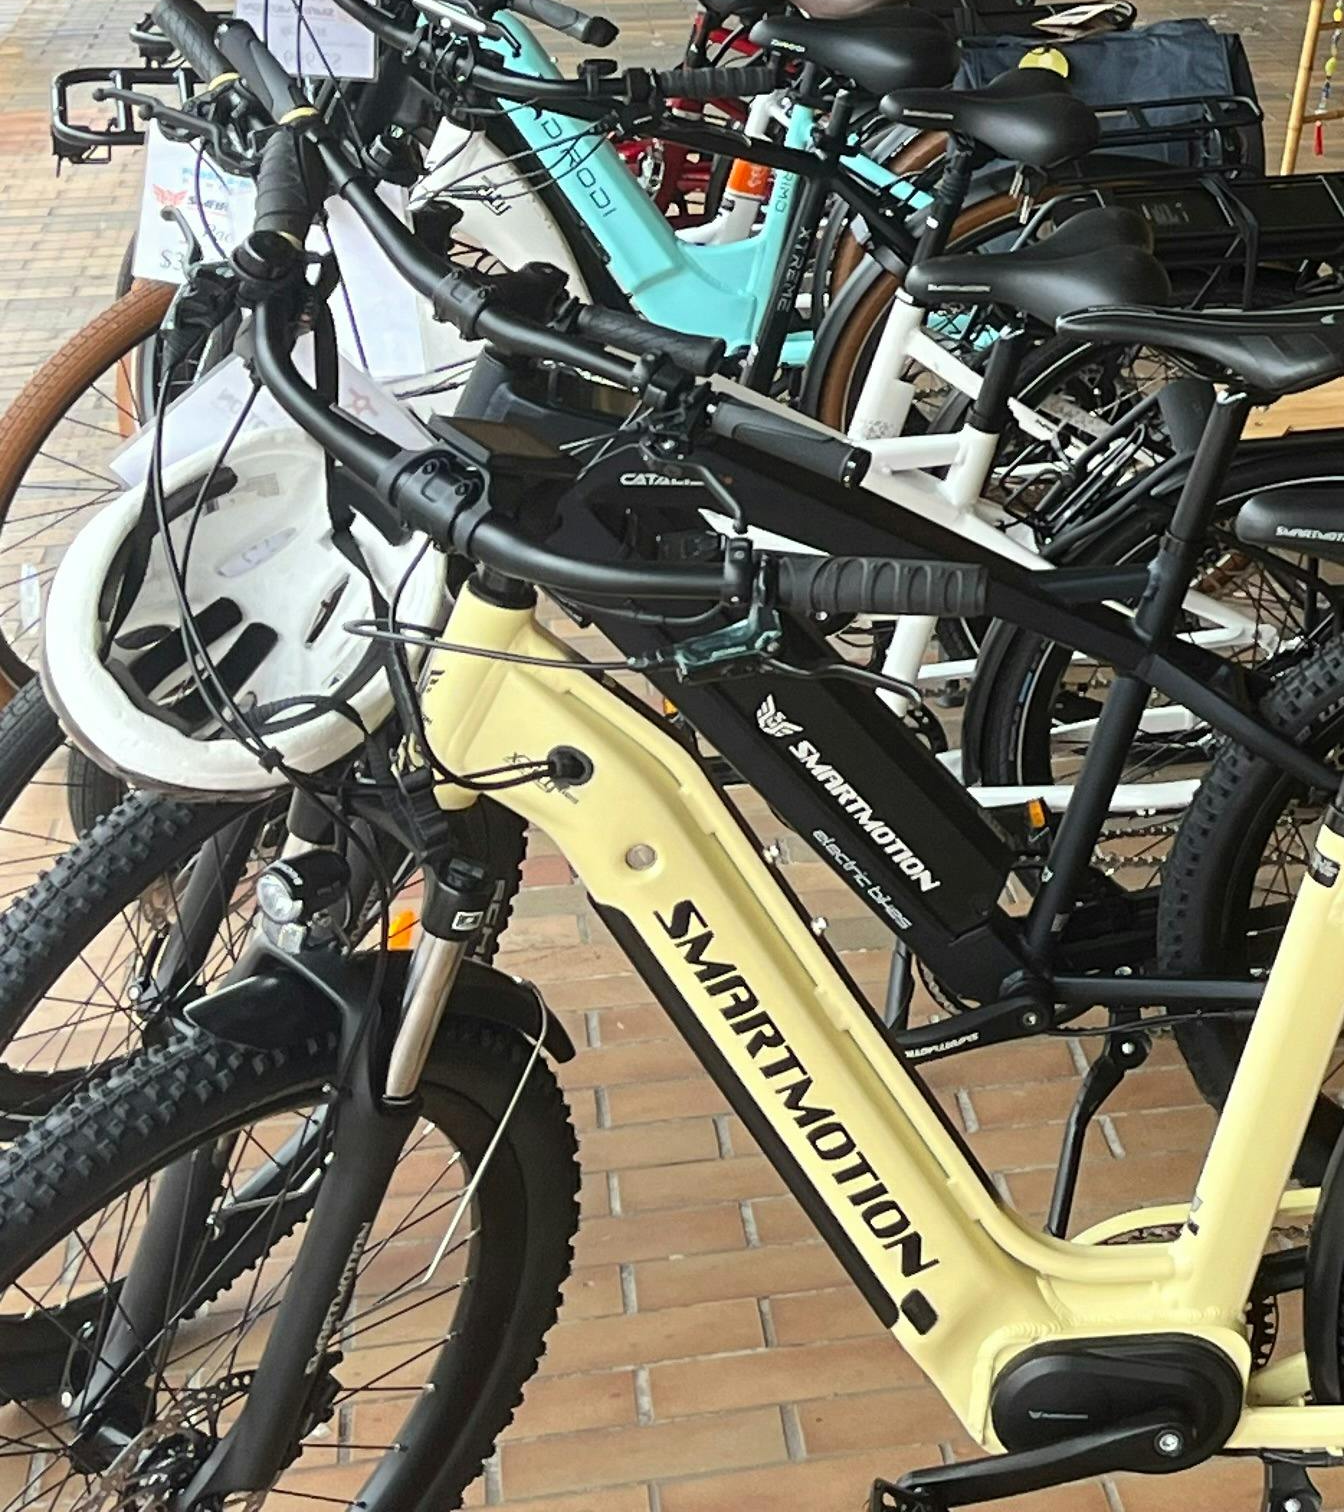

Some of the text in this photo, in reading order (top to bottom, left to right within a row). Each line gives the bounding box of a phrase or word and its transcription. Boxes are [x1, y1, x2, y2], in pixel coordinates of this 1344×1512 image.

[541, 117, 617, 217] DRODI
[776, 225, 812, 313] XTREME
[788, 740, 941, 893] SMARTMOTION
[813, 829, 913, 931] electric bikes
[653, 899, 940, 1278] SMARTMOTION
